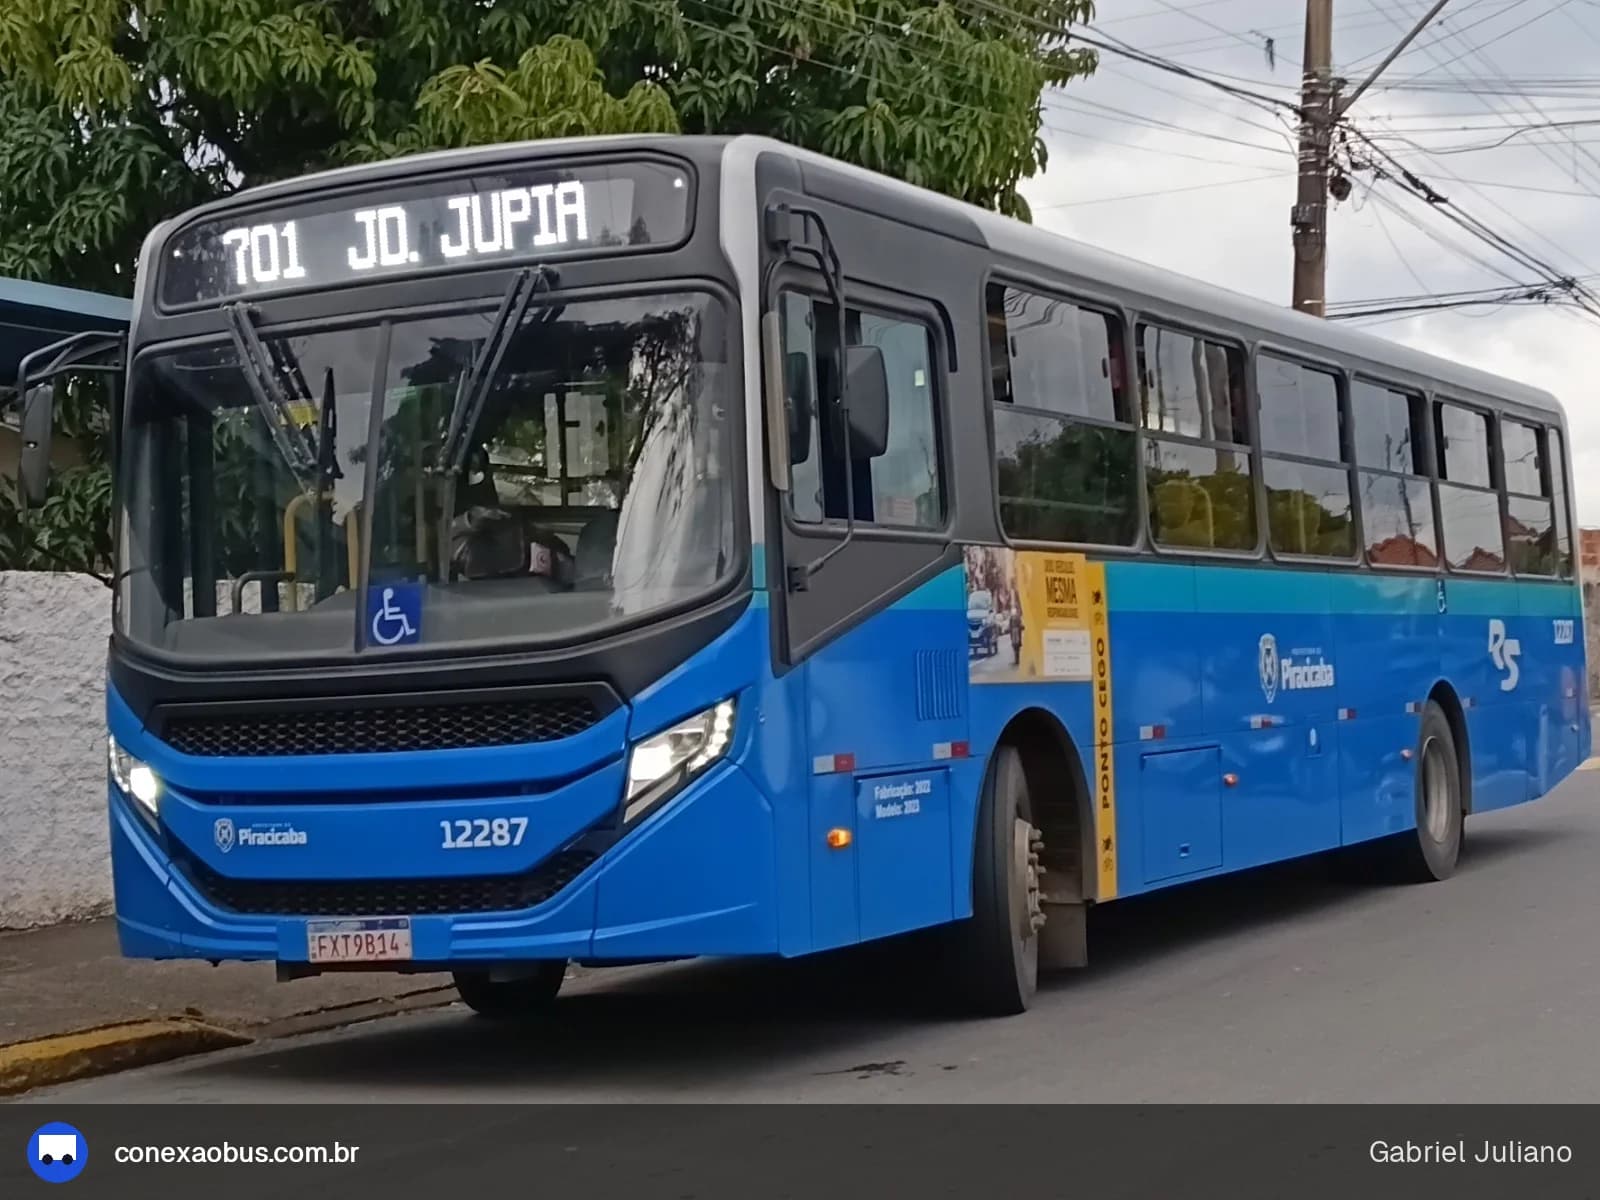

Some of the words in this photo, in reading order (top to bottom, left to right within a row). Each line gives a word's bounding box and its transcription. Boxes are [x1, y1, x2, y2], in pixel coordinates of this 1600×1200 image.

[223, 220, 306, 285] 701
[440, 180, 588, 259] JUPIA
[1096, 637, 1107, 708] CEGO
[1100, 717, 1110, 809] PONTO
[238, 828, 308, 846] Piracicaba
[440, 817, 529, 849] 12287
[317, 932, 400, 958] FXT9B14
